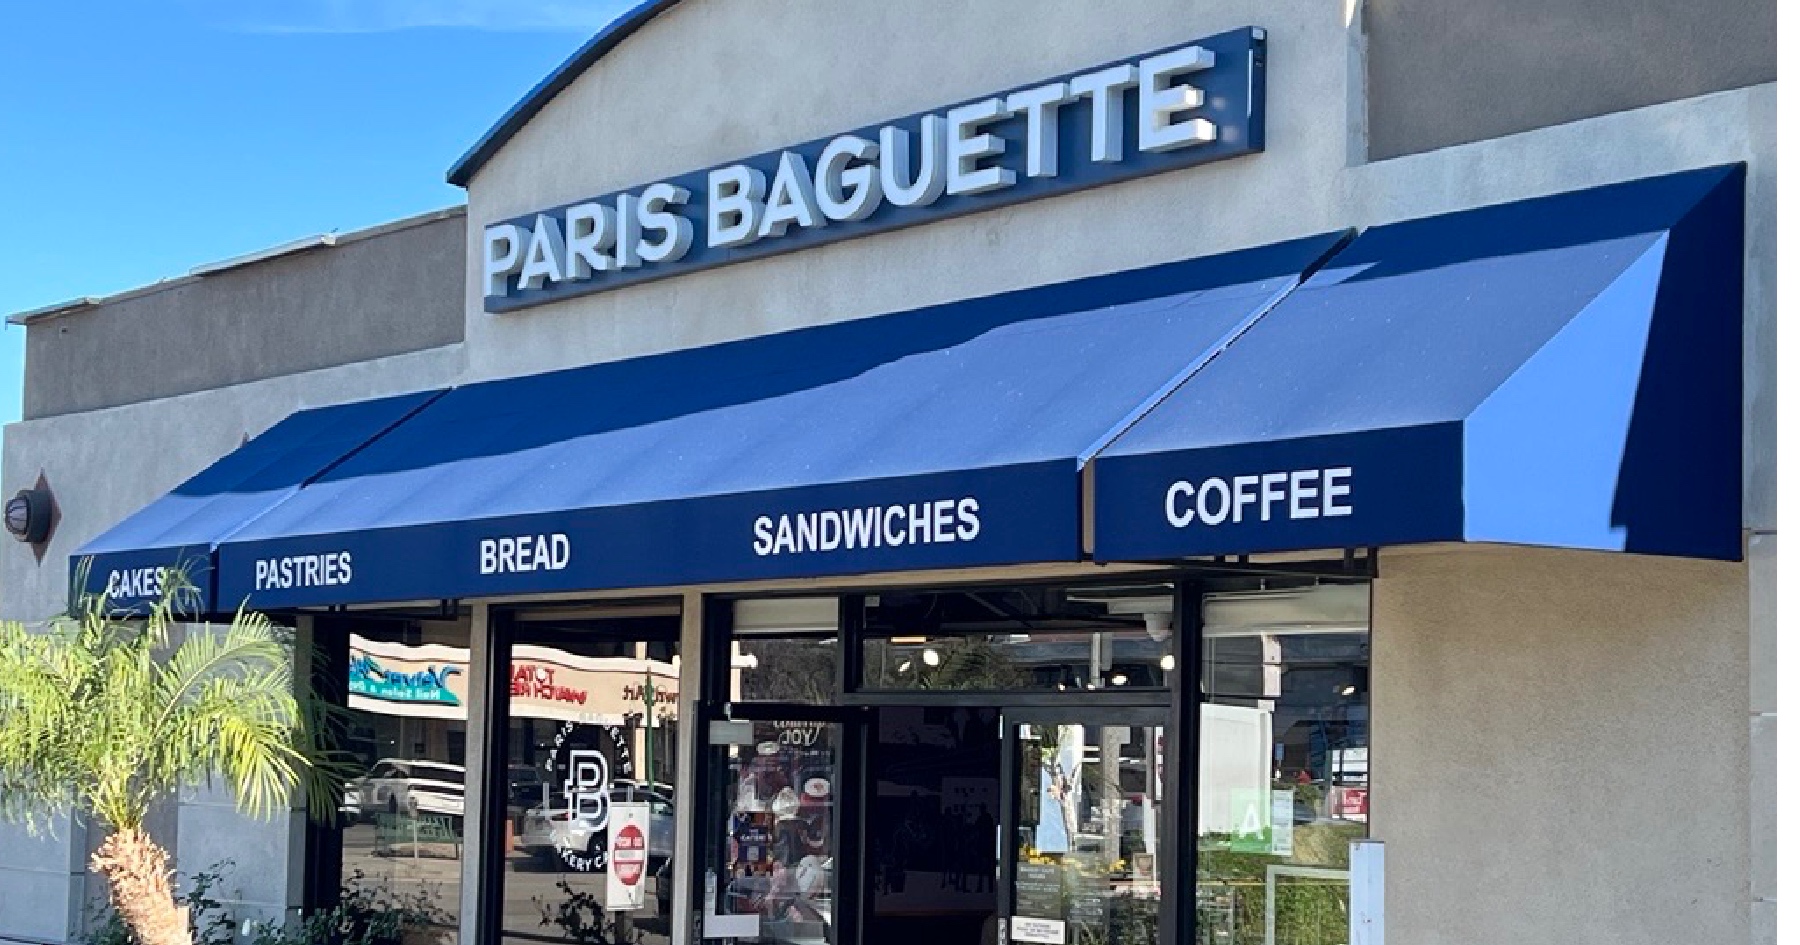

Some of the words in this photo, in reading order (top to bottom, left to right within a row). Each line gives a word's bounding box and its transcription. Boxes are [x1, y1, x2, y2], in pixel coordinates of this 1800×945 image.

[484, 182, 693, 298] PARIS
[707, 46, 1217, 249] BAGUETTE
[1165, 466, 1353, 528] COFFEE
[753, 497, 980, 556] SANDWICHES
[255, 551, 352, 591] PASTRIES
[480, 533, 570, 574] BREAD
[108, 566, 164, 598] CAKES
